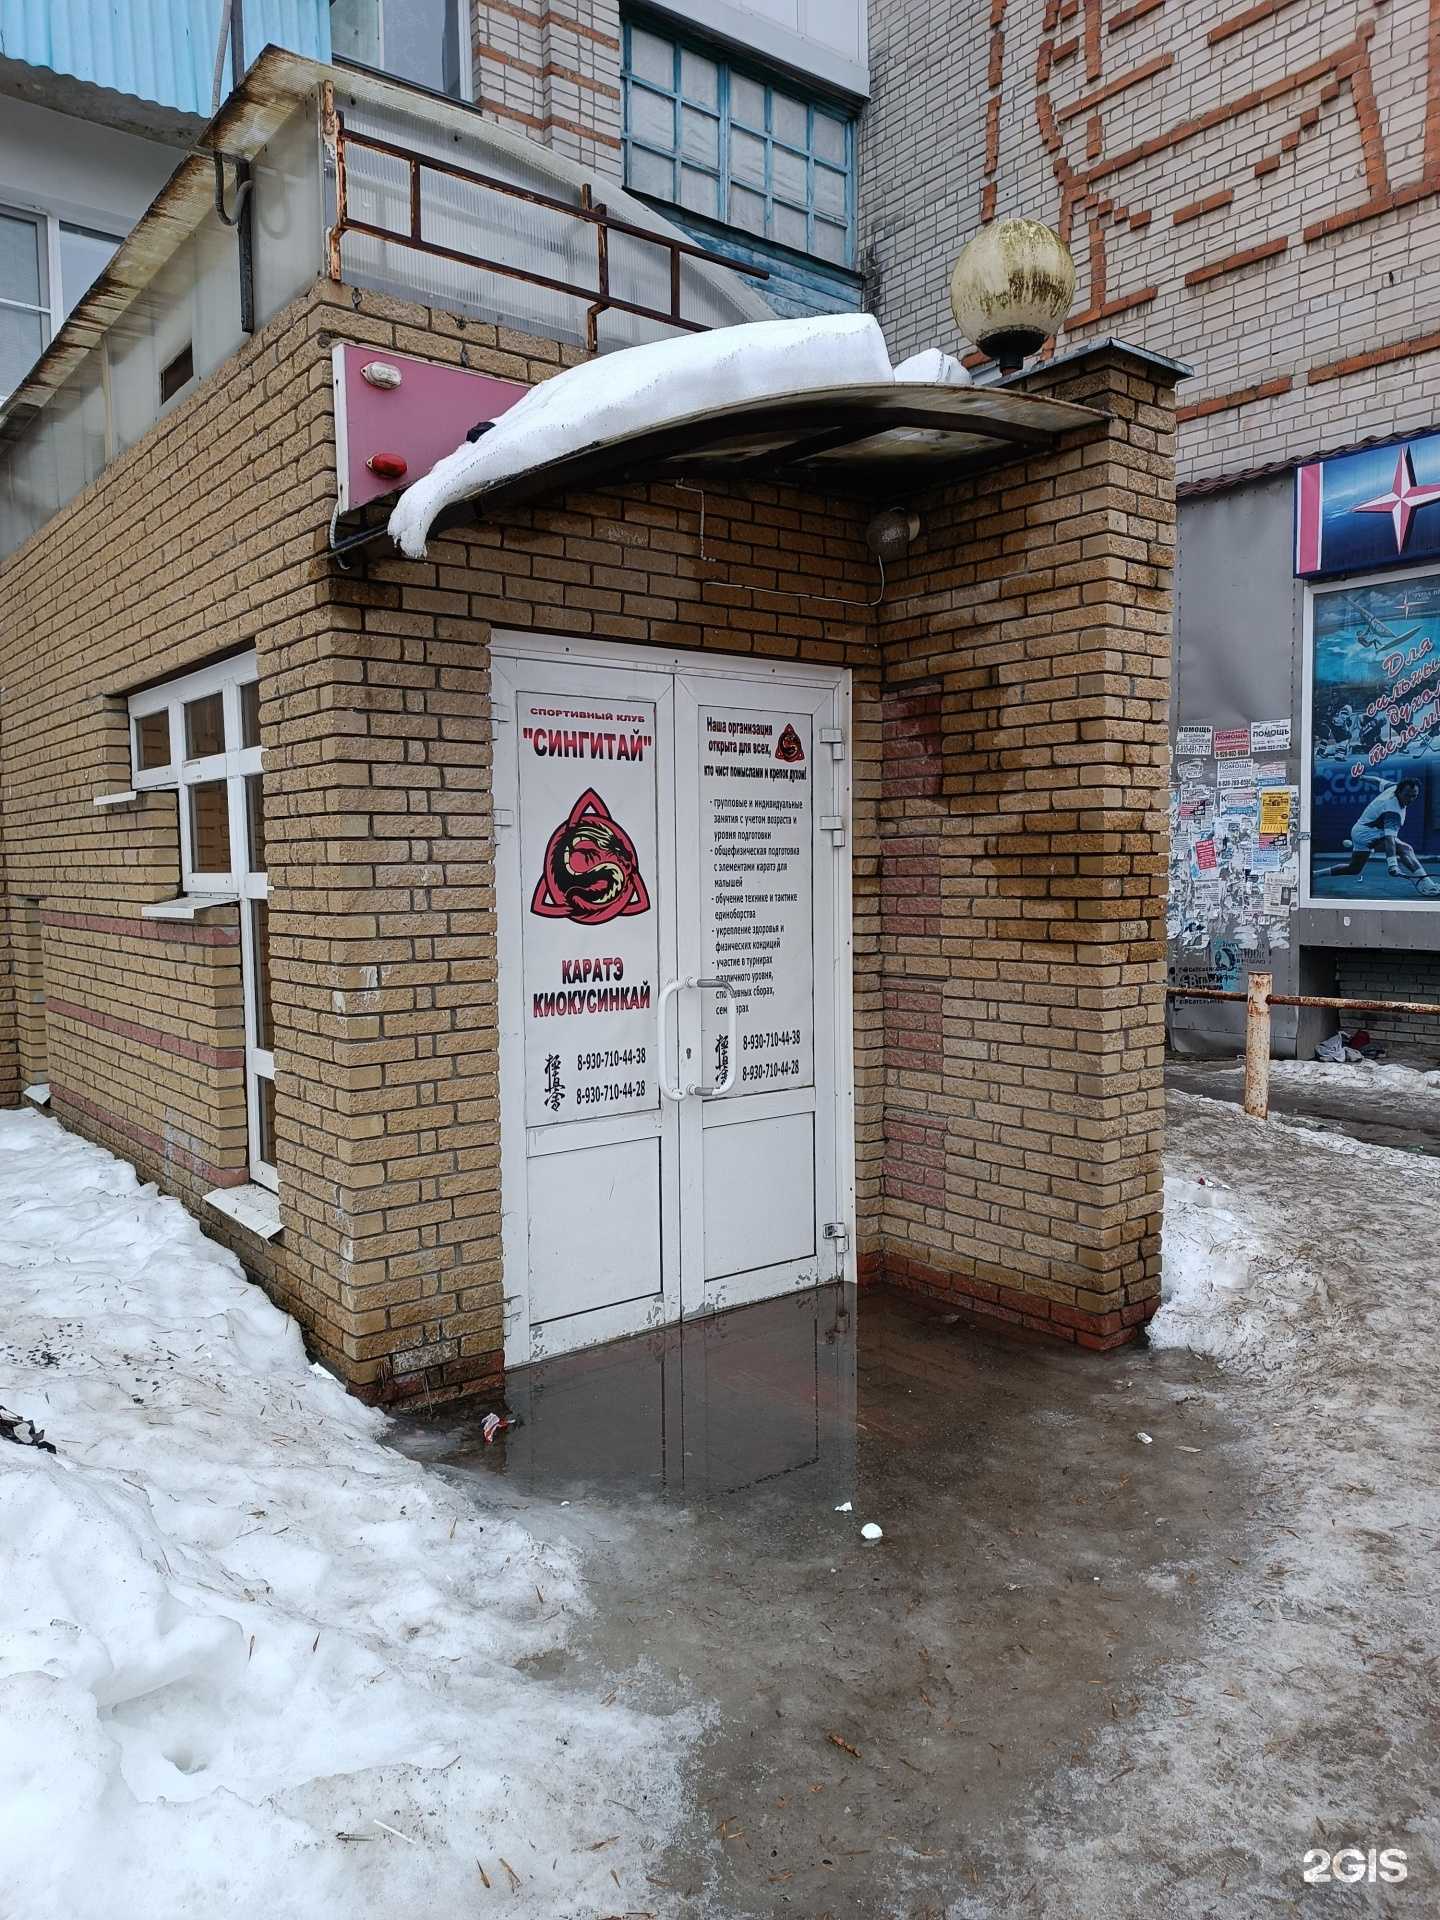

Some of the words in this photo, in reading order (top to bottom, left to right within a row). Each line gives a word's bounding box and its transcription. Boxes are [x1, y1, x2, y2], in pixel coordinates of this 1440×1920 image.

[1366, 657, 1440, 717] сильны
[530, 707, 613, 721] СПОРТИВНЫЙ
[616, 714, 645, 723] КЛУБ
[706, 716, 726, 733] Наша
[728, 720, 773, 738] организация
[522, 727, 652, 761] "СИНГИТАЙ"
[708, 740, 737, 757] открыта
[738, 742, 752, 757] для
[753, 743, 772, 759] всех,
[703, 765, 714, 777] кто
[715, 765, 730, 777] чист
[730, 765, 763, 779] помыслами
[713, 799, 748, 810] групповые
[754, 799, 803, 811] индивидуальные
[713, 814, 739, 824] занятия
[745, 815, 766, 827] учетом
[767, 815, 792, 827] возраста
[713, 831, 737, 842] уровня
[738, 831, 772, 842] подготовки
[714, 844, 767, 858] общефизическая
[768, 847, 800, 857] подготовка
[719, 863, 755, 872] элементами
[756, 863, 776, 874] каратэ
[777, 863, 788, 872] для
[713, 876, 743, 888] малышей
[715, 893, 744, 906] обучение
[744, 894, 769, 903] технике
[774, 893, 799, 902] тактике
[714, 908, 757, 922] единоборства
[715, 926, 751, 939] укрепление
[752, 925, 780, 936] здоровья
[715, 941, 751, 954] физических
[752, 937, 781, 949] кондиций
[561, 957, 624, 985] КАРАТЭ
[716, 958, 741, 970] участие
[746, 956, 773, 968] турнирах
[532, 979, 651, 1018] КИОКУСИНКАЙ
[743, 1029, 801, 1051] 8-930-710-44-38
[577, 1048, 647, 1071] 8-930-710-44-38
[742, 1059, 799, 1082] 8-930-710-44-28
[575, 1080, 646, 1105] 8-930-710-44-28
